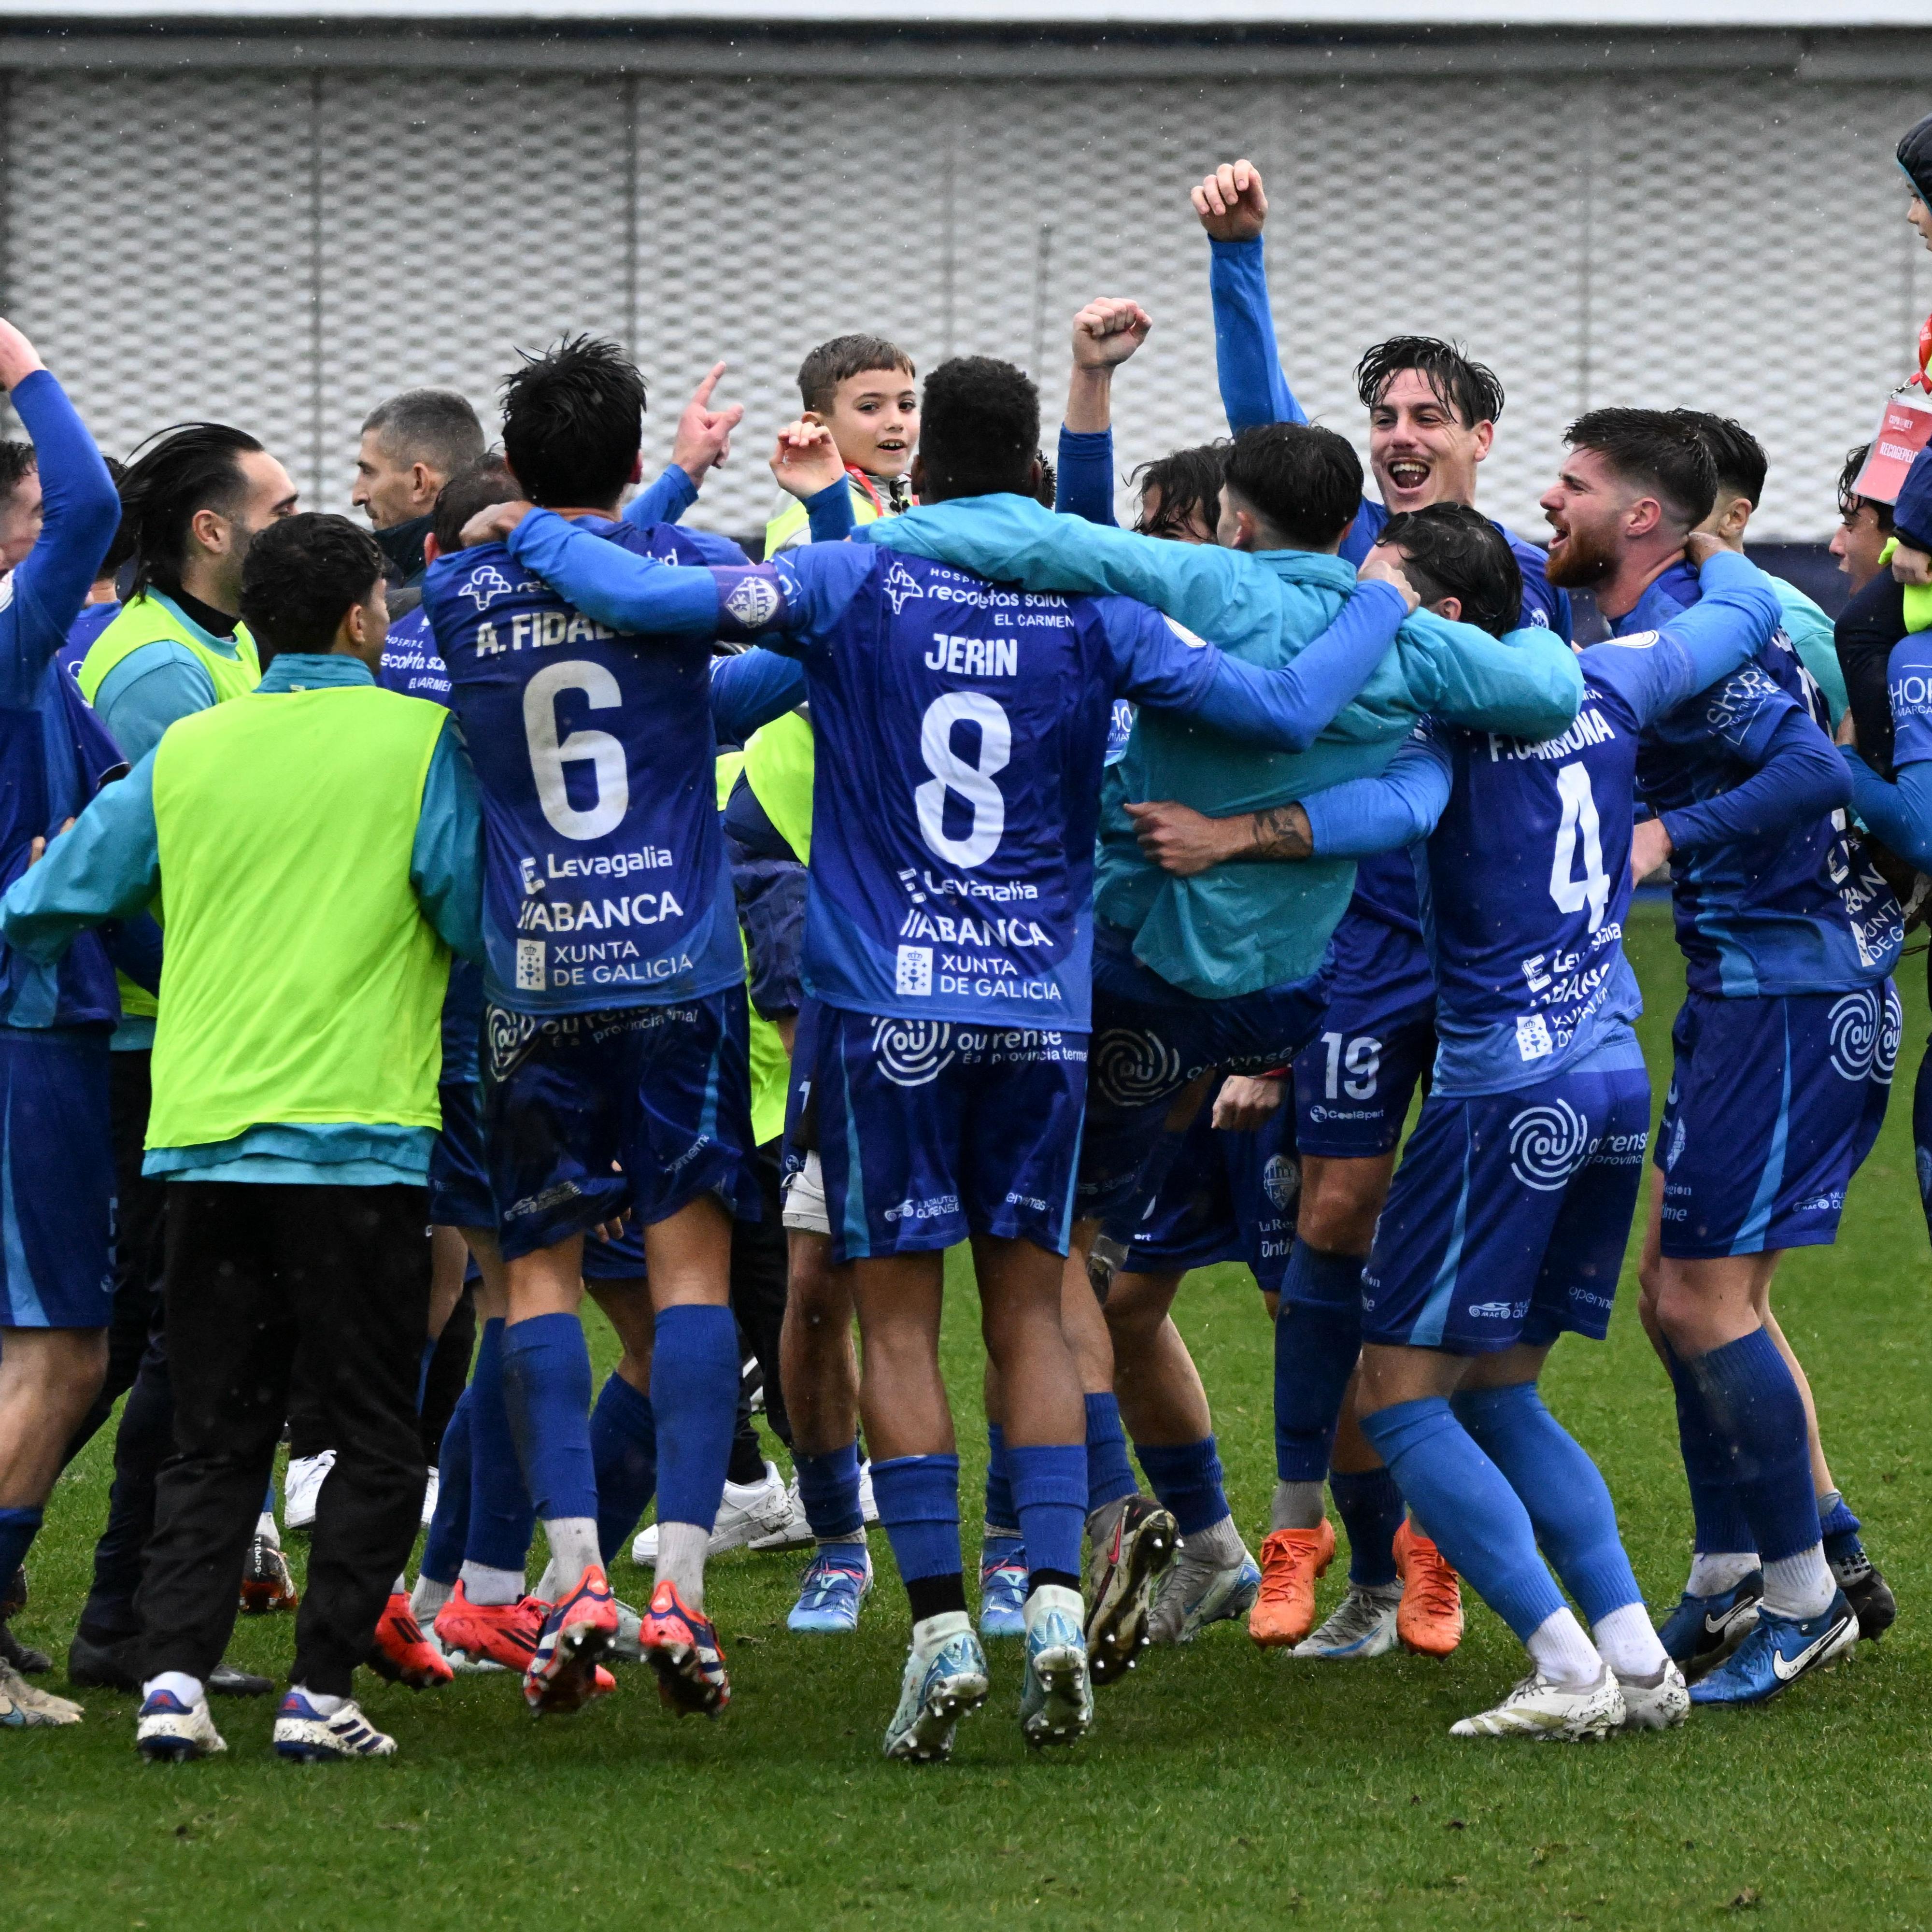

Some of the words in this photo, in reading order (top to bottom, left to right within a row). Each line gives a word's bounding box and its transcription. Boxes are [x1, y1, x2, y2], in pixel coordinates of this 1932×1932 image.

[994, 614, 1013, 626] EL
[1017, 614, 1075, 628] CARMEN
[476, 622, 507, 658] A.
[924, 633, 1018, 676] JERIN
[523, 660, 629, 841] 6
[915, 691, 1012, 869] 8
[547, 846, 673, 879] Levagalia
[1550, 761, 1610, 934] 4
[554, 940, 640, 964] XUNTA
[941, 953, 1018, 976] XUNTA
[554, 968, 586, 987] DE
[593, 954, 694, 984] GALICIA
[941, 975, 969, 995] DE
[975, 978, 1062, 1000] GALICIA
[1320, 1032, 1383, 1100] 19
